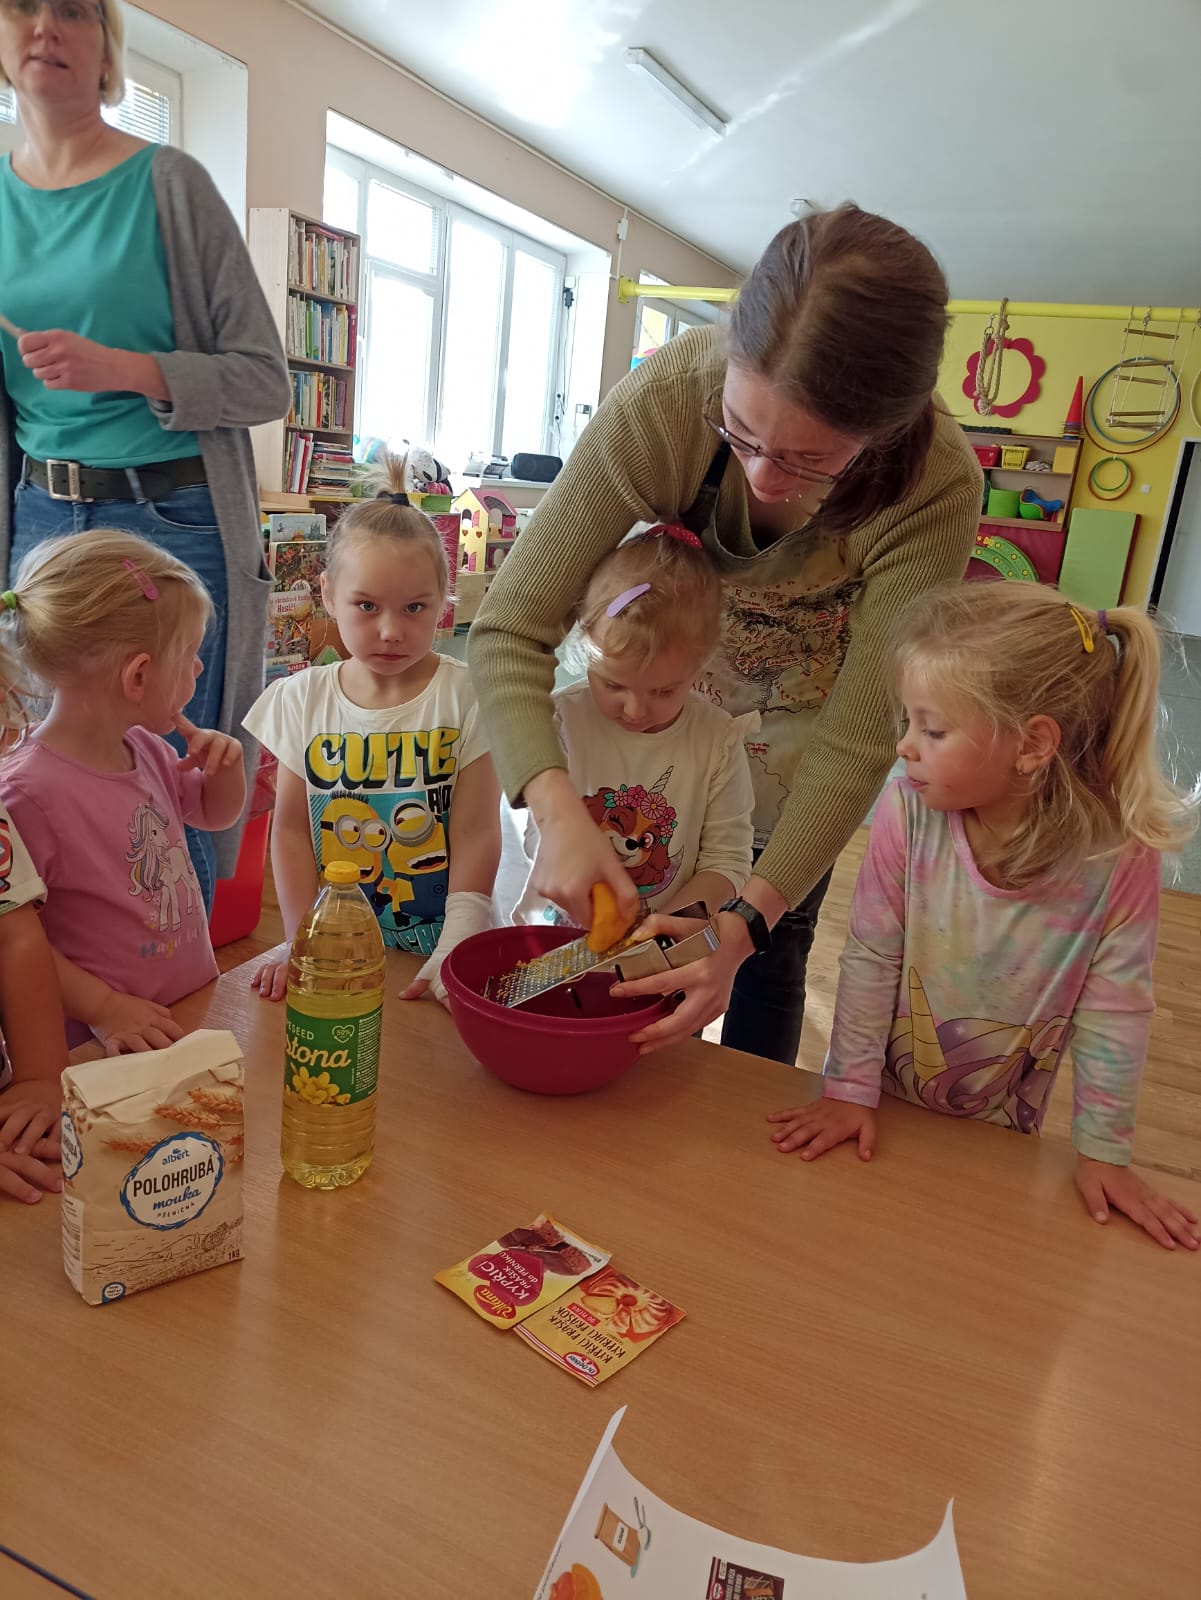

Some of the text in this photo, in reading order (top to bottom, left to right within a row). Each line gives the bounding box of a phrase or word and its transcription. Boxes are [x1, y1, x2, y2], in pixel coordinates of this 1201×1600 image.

[305, 727, 460, 790] CUTE
[162, 1148, 190, 1166] albert
[133, 1155, 215, 1197] POLOHRUBÁ
[152, 1186, 202, 1210] mouka
[499, 1251, 531, 1279] PERNÍKU
[502, 1265, 532, 1289] PRÁŠEK
[476, 1260, 530, 1300] KYPŘICÍ
[479, 1287, 513, 1318] Vitana
